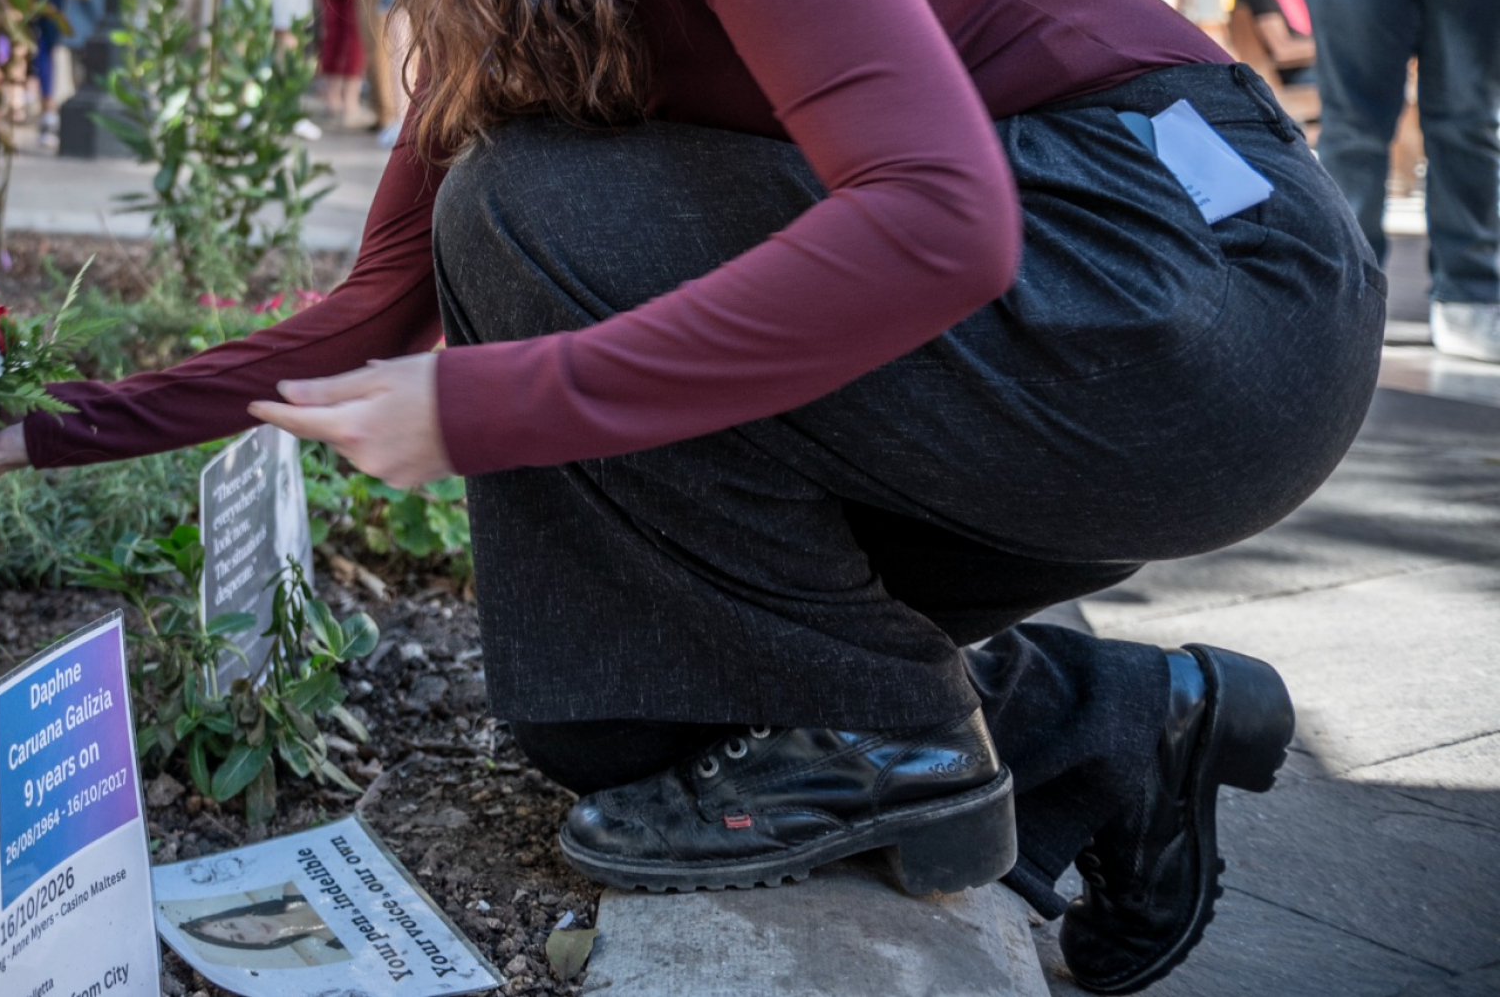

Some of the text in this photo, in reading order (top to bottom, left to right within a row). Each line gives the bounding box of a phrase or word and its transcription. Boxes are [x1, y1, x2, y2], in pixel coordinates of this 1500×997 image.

[30, 662, 82, 710] Daphne
[8, 688, 113, 771] Caruana Galizia
[24, 741, 100, 807] 9 years on
[5, 808, 60, 866] 26/08/1964
[67, 768, 127, 817] 16/10/2017
[330, 835, 362, 865] own
[297, 847, 355, 911] indelible
[354, 867, 385, 894] our
[0, 866, 75, 946] 16/10/2026
[11, 934, 30, 960] Anne
[31, 915, 55, 944] Myers
[60, 891, 89, 917] Casino
[90, 868, 127, 895] Maltese
[382, 899, 424, 940] voice
[351, 914, 390, 945] pen
[103, 963, 129, 989] City
[373, 942, 414, 982] Your
[415, 938, 457, 978] Your
